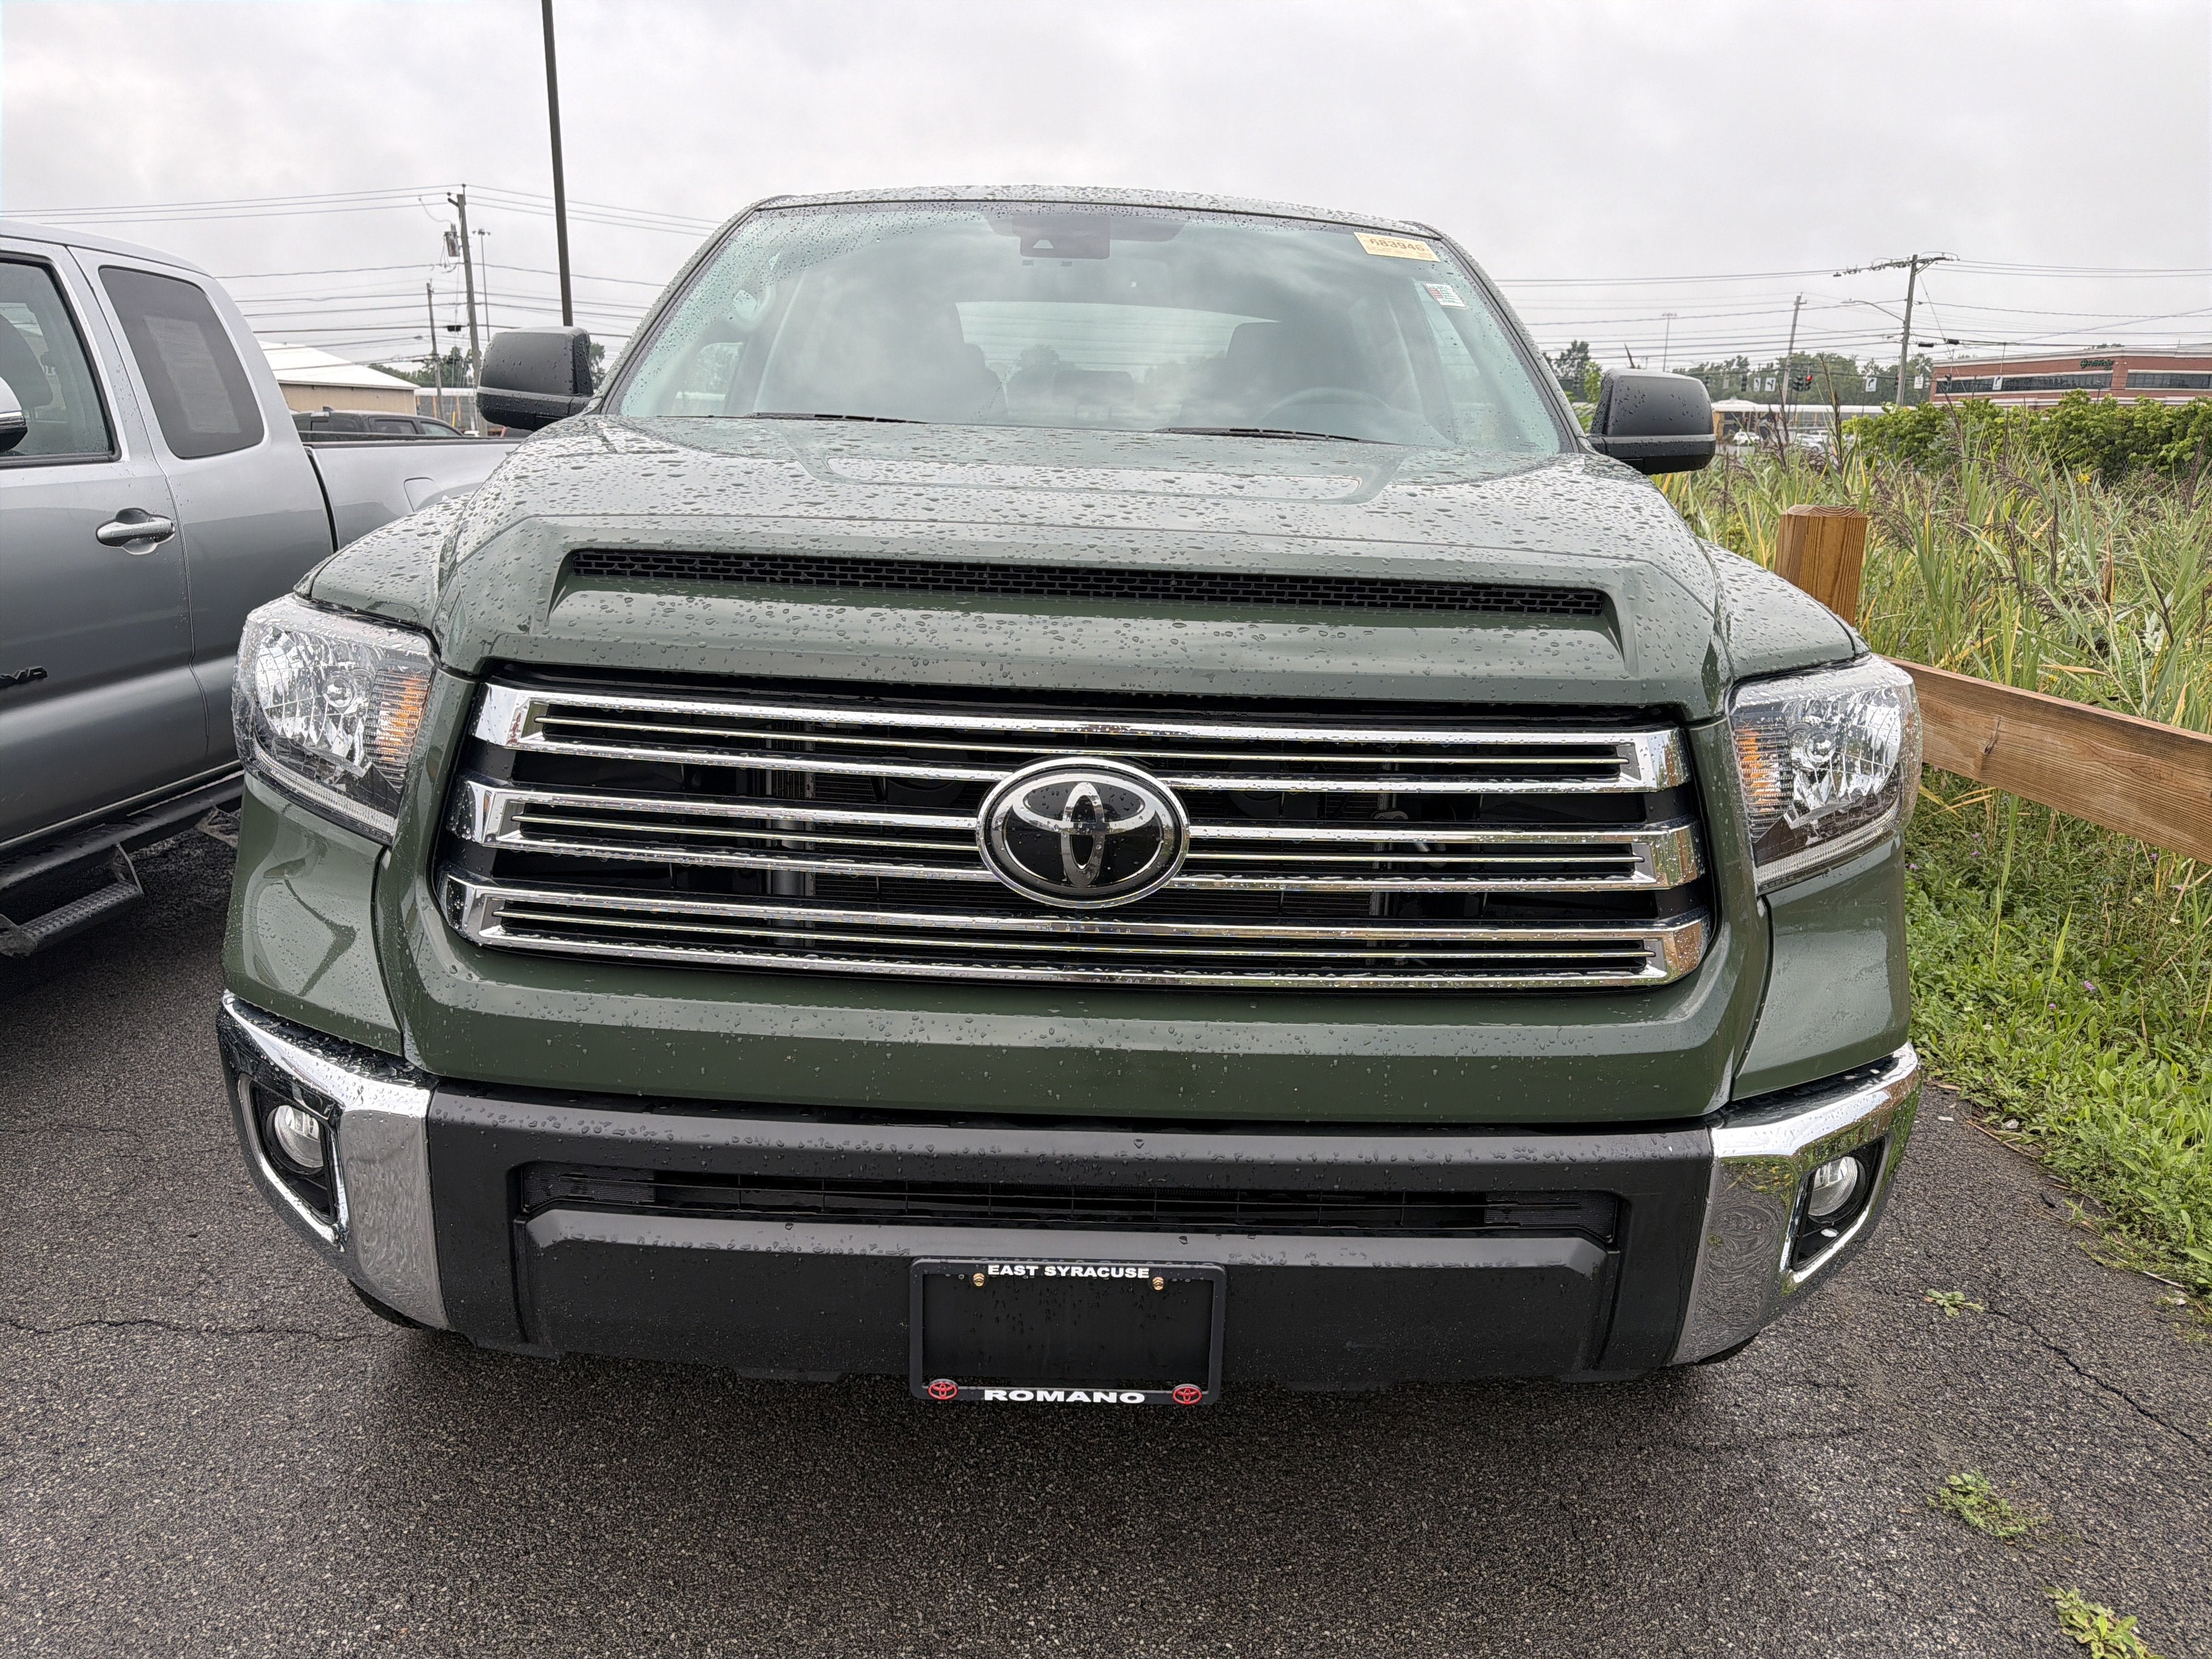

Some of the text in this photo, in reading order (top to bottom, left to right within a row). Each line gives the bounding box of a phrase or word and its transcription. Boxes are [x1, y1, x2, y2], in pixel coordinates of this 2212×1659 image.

[1369, 239, 1425, 252] 683946
[988, 1265, 1150, 1279] EAST SYRACUSE
[984, 1390, 1146, 1404] ROMANO
